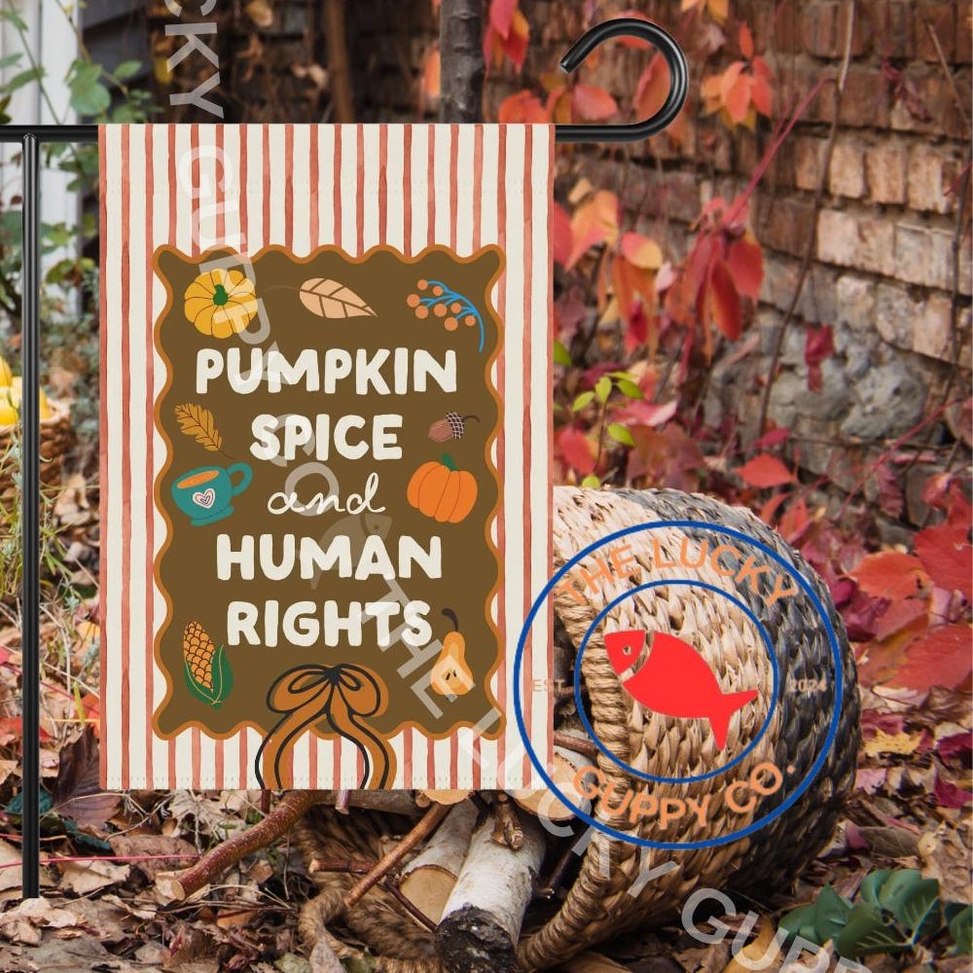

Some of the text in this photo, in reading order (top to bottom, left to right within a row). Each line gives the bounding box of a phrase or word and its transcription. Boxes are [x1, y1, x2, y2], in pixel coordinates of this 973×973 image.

[195, 346, 457, 395] PUMPKIN
[249, 413, 403, 461] SPICE
[267, 472, 386, 515] and
[216, 533, 442, 581] HUMAN
[226, 599, 433, 648] RIGHTS
